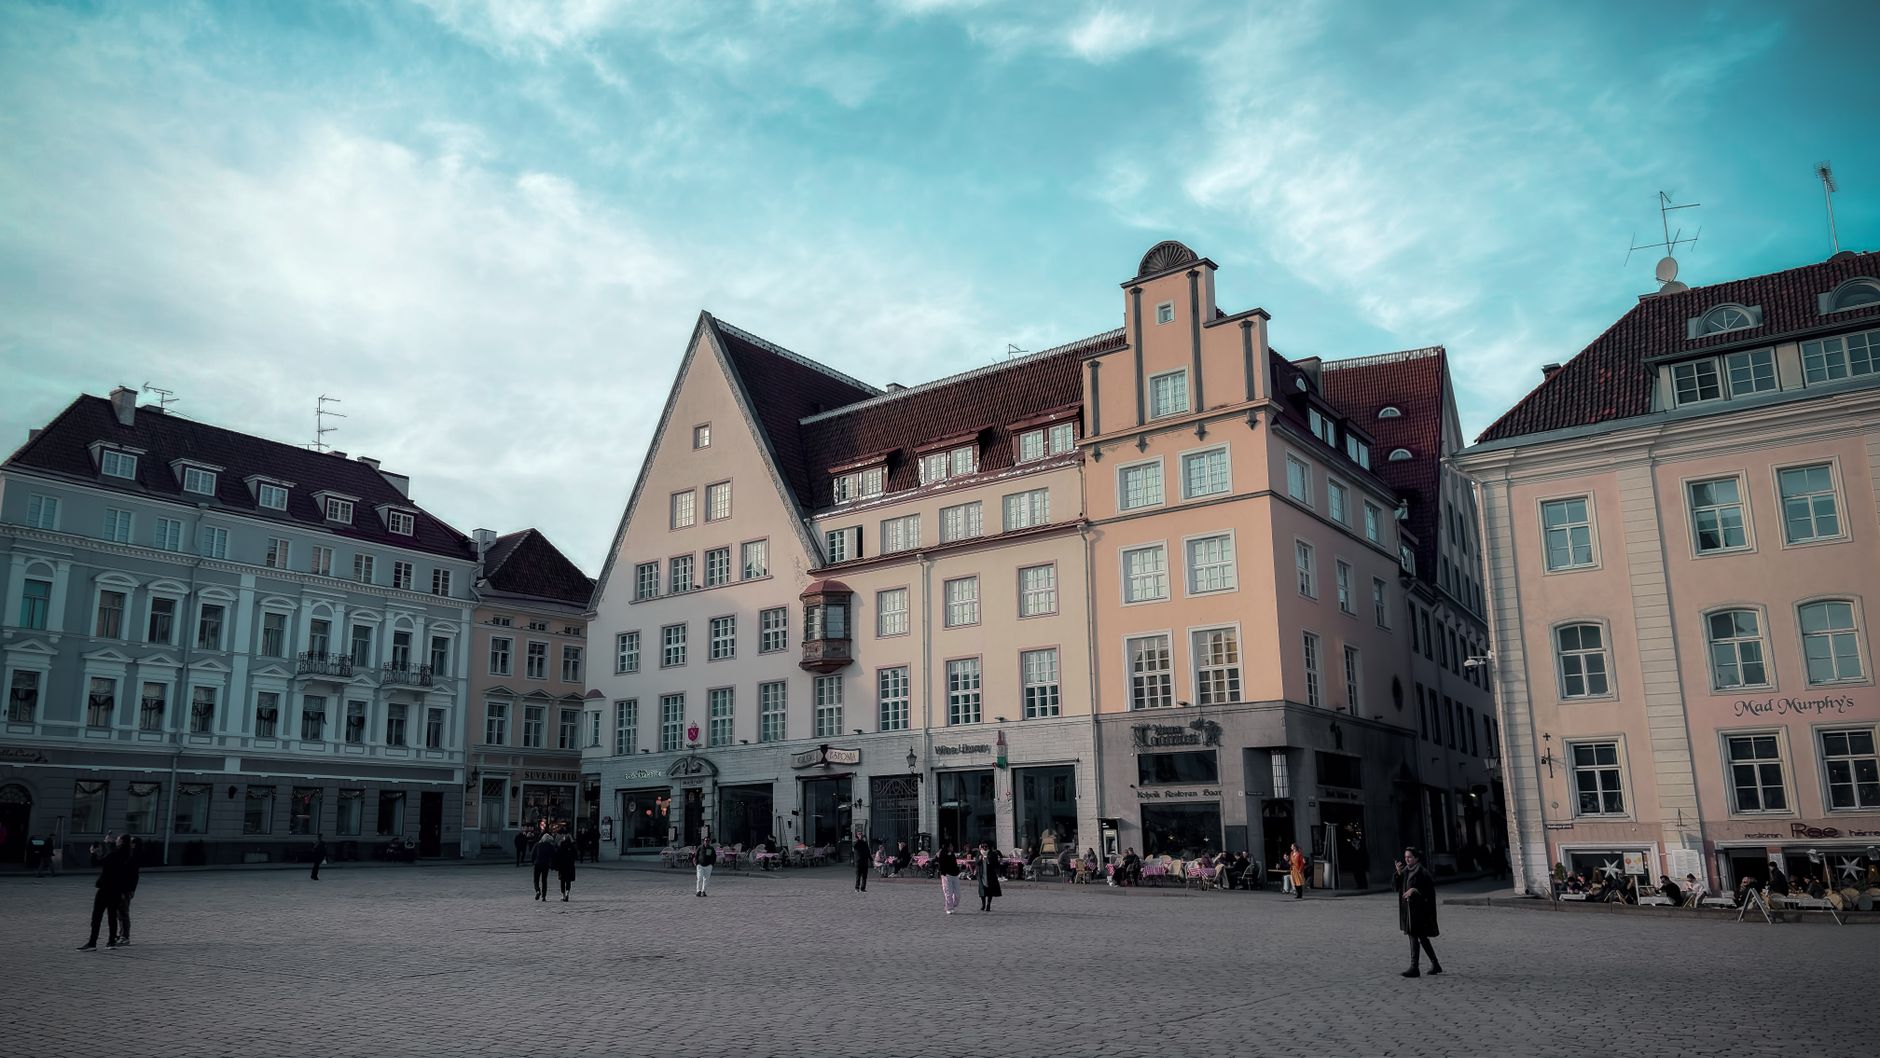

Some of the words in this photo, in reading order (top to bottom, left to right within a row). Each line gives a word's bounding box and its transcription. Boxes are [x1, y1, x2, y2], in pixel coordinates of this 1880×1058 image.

[1734, 699, 1773, 717] Mad
[1778, 695, 1854, 715] Murphy's
[1790, 823, 1839, 838] Rae
